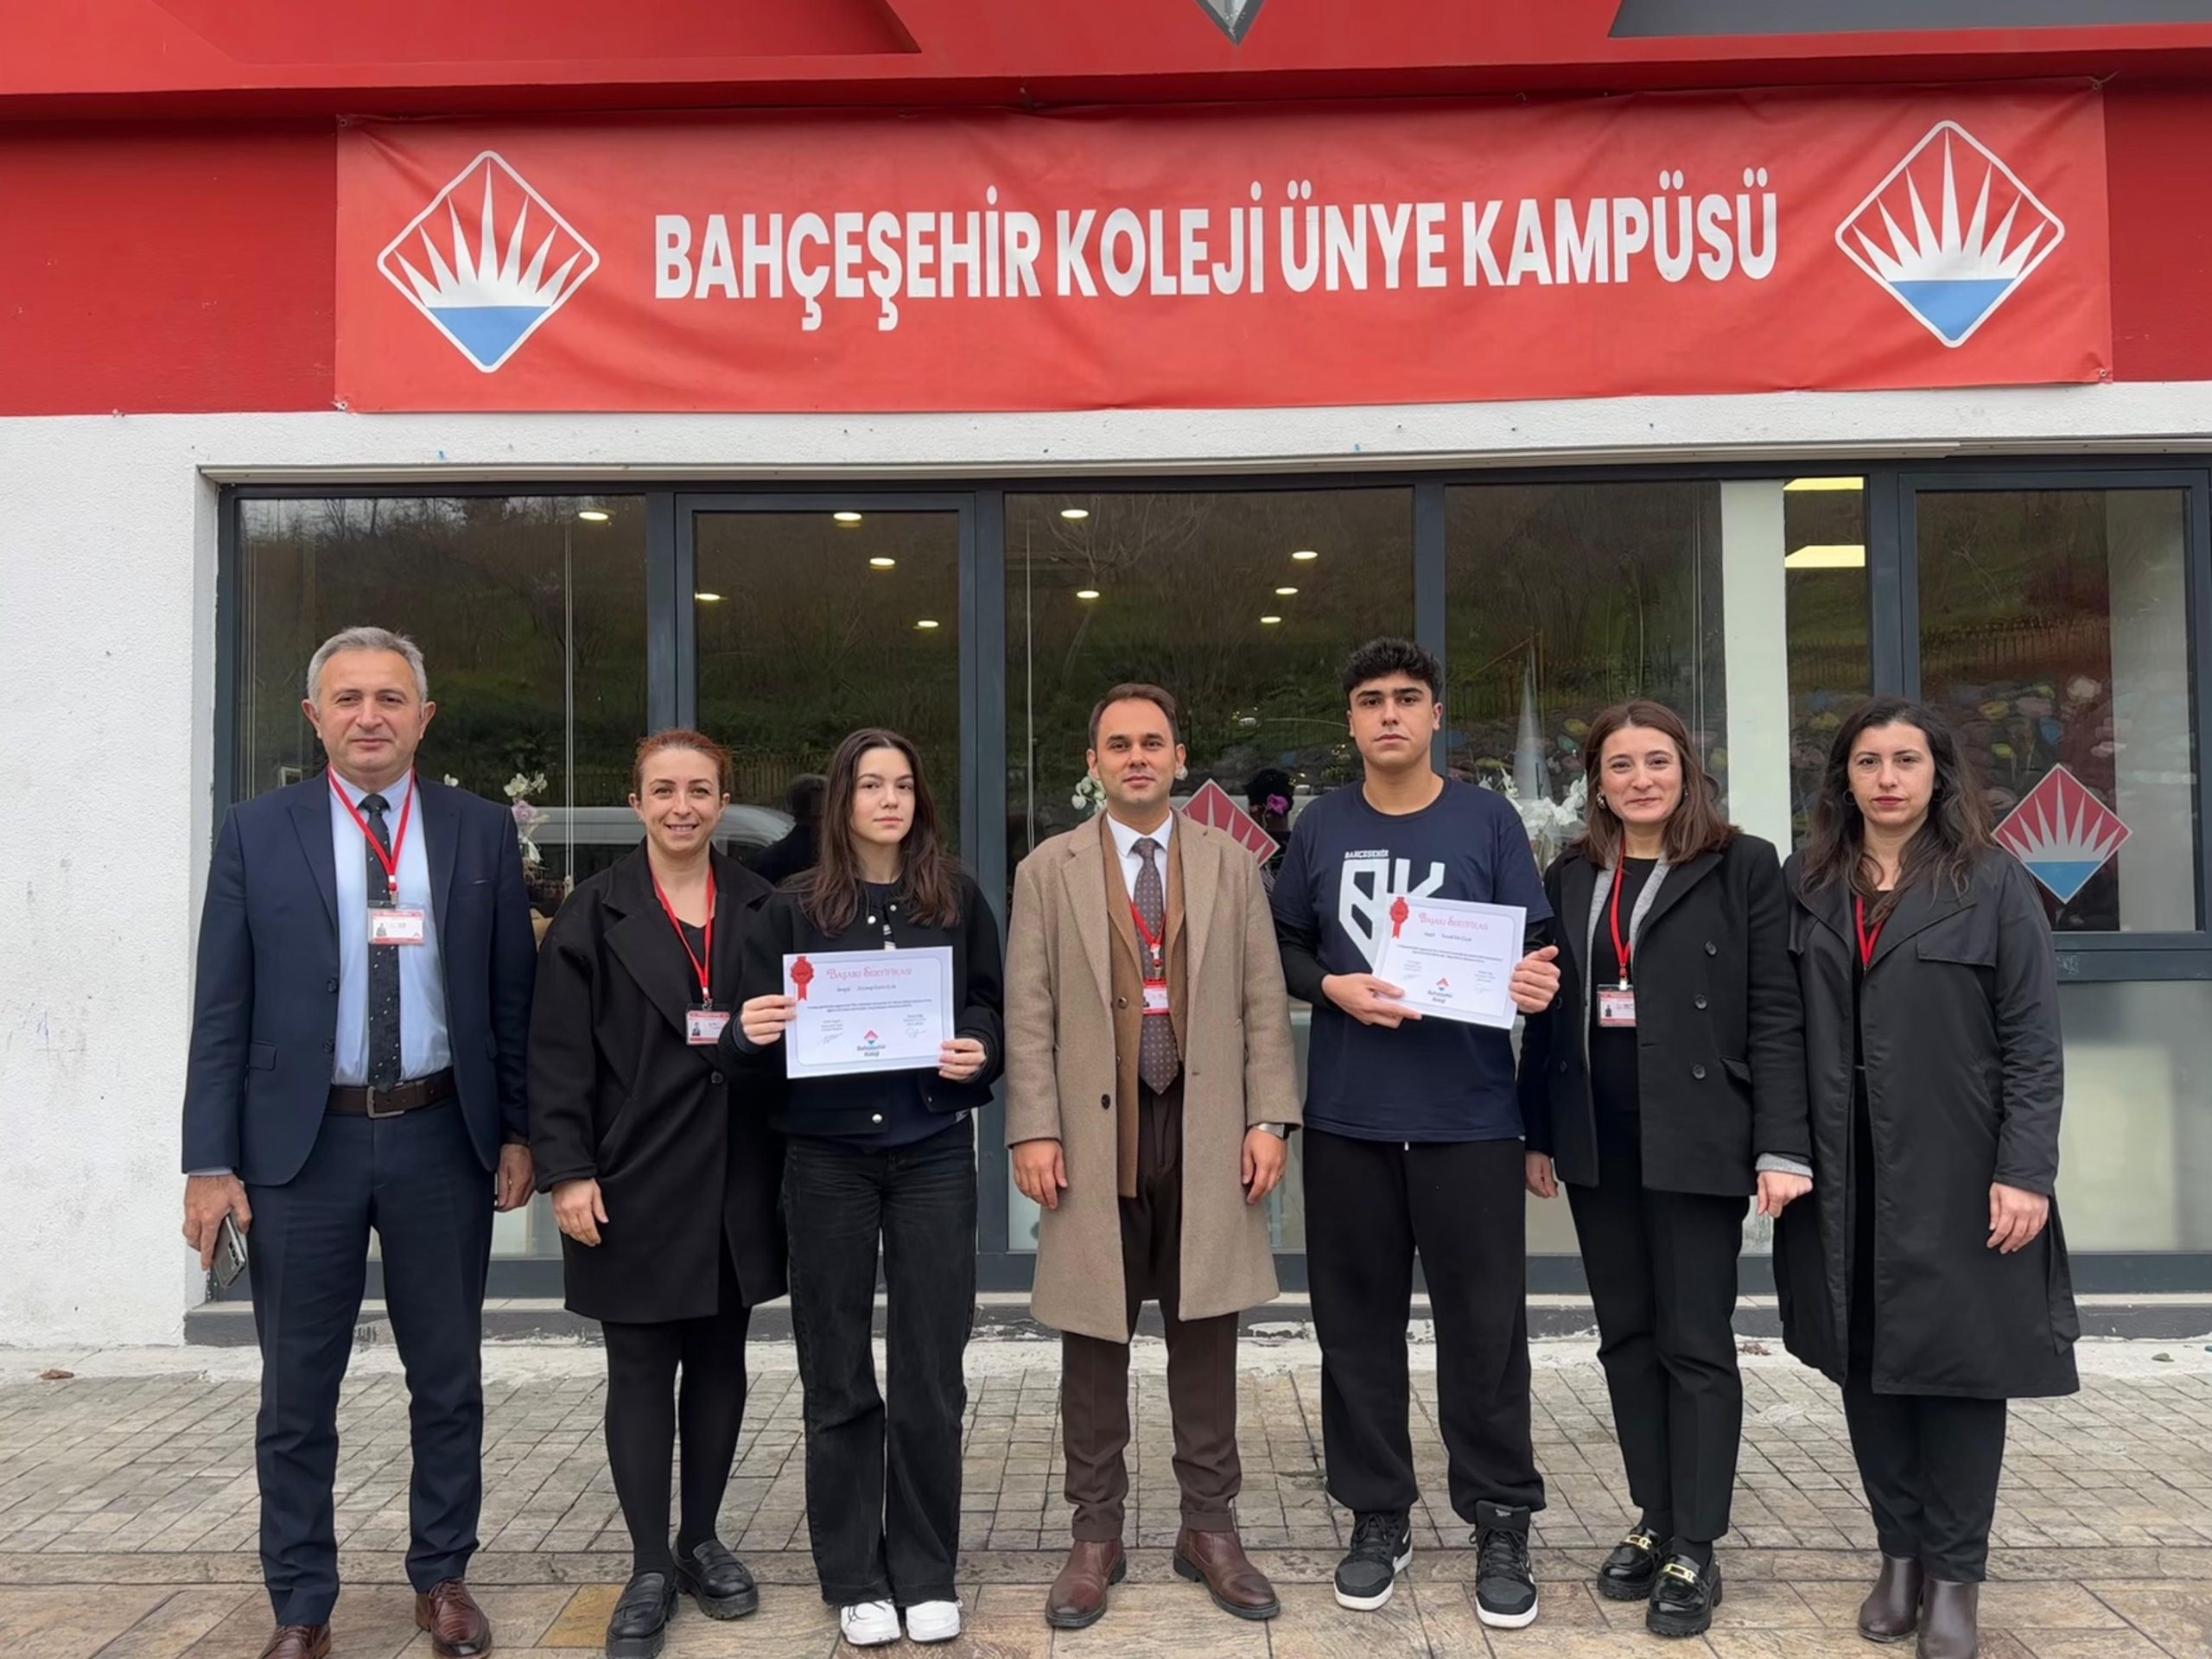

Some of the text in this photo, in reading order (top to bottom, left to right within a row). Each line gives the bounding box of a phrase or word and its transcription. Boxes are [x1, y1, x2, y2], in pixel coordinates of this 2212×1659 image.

[655, 167, 1778, 332] BAHÇEŞEHİR KOLEJİ ÜNYE KAMPÜSÜ
